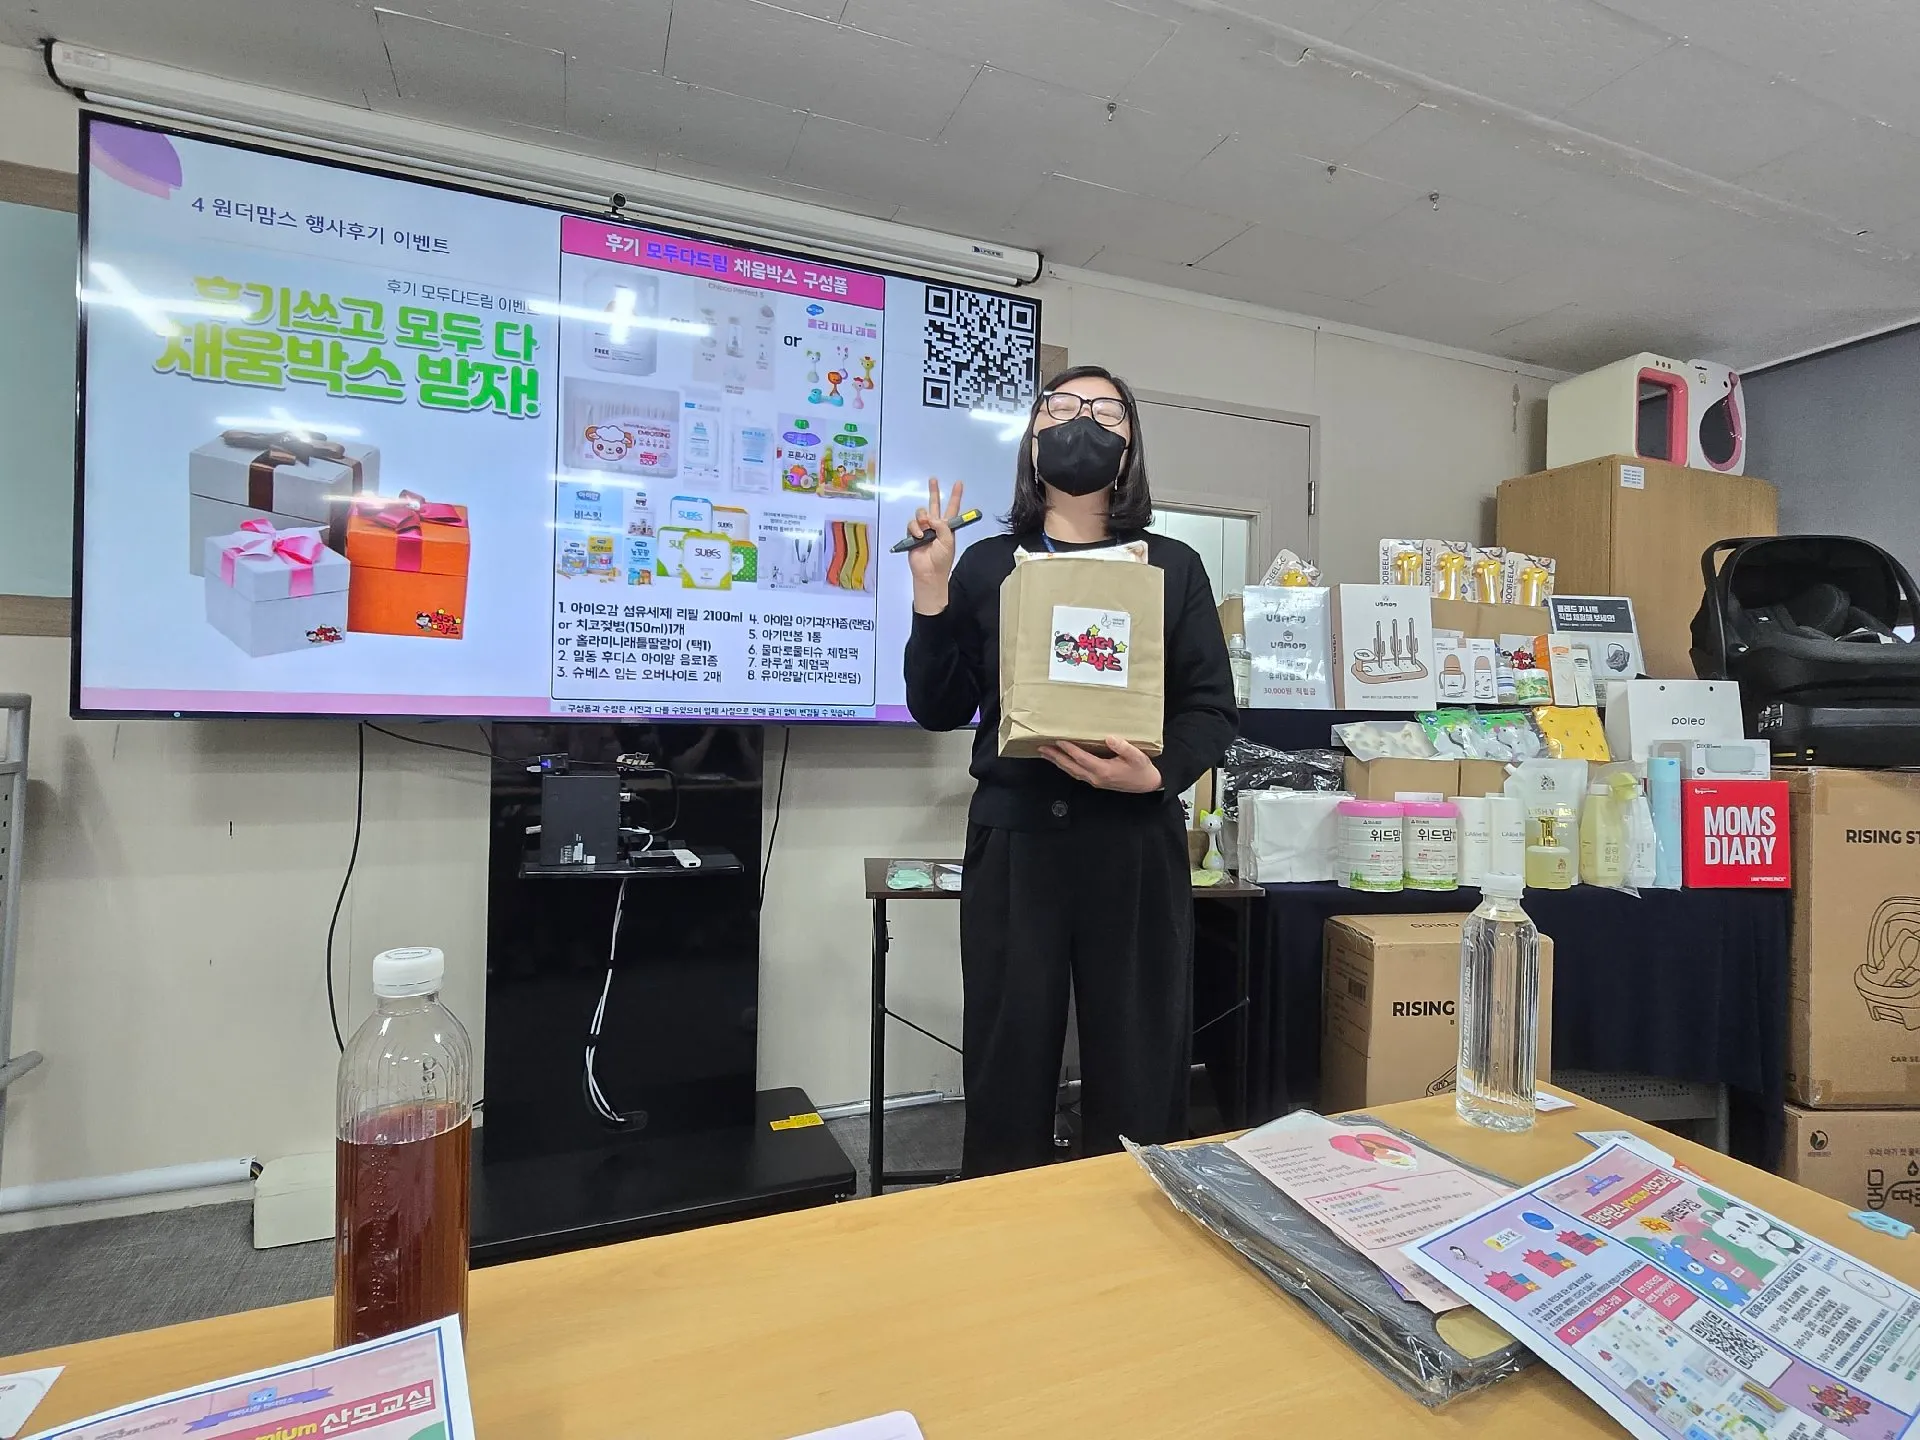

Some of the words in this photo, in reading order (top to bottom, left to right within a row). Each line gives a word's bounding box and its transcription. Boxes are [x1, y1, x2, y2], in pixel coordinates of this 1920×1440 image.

[191, 197, 205, 212] 4
[212, 198, 298, 228] 원더맘스
[305, 214, 384, 245] 행사후기
[393, 231, 451, 254] 이벤트
[606, 233, 640, 257] 후기
[646, 242, 728, 273] 모두다드림
[734, 258, 798, 285] 채움박스
[803, 271, 848, 296] 구성품
[386, 279, 417, 297] 후기
[422, 284, 493, 310] 모두다드림
[396, 305, 485, 356] 모두
[494, 320, 540, 364] 다
[784, 335, 802, 347] or
[558, 602, 566, 613] 1.
[571, 602, 618, 616] 아이오감
[623, 605, 672, 619] 섬유세제
[676, 608, 698, 621] 리필
[703, 610, 743, 623] 2100ml
[558, 621, 572, 629] or
[576, 618, 685, 635] 치코젖병(150ml)1개
[748, 629, 758, 640] 5.
[558, 637, 572, 645] or
[686, 639, 712, 652] (택1)
[748, 644, 757, 655] 6.
[558, 650, 568, 661] 2.
[573, 651, 597, 662] 일동
[601, 651, 637, 663] 후디스
[679, 654, 719, 667] 음료1종
[557, 667, 568, 678] 3.
[572, 666, 610, 679] 슈베스
[614, 668, 637, 681] 입는
[641, 669, 699, 682] 오버나이트
[702, 670, 722, 683] 2매
[761, 670, 861, 684] 유아양말(디자인랜덤)
[1671, 716, 1706, 726] poled
[1704, 806, 1776, 836] MOMS
[1417, 828, 1453, 842] 위드맘
[1845, 829, 1902, 844] RISING
[1705, 836, 1776, 865] DIARY
[1392, 1001, 1455, 1016] RISING
[320, 1388, 433, 1433] 산모교실
